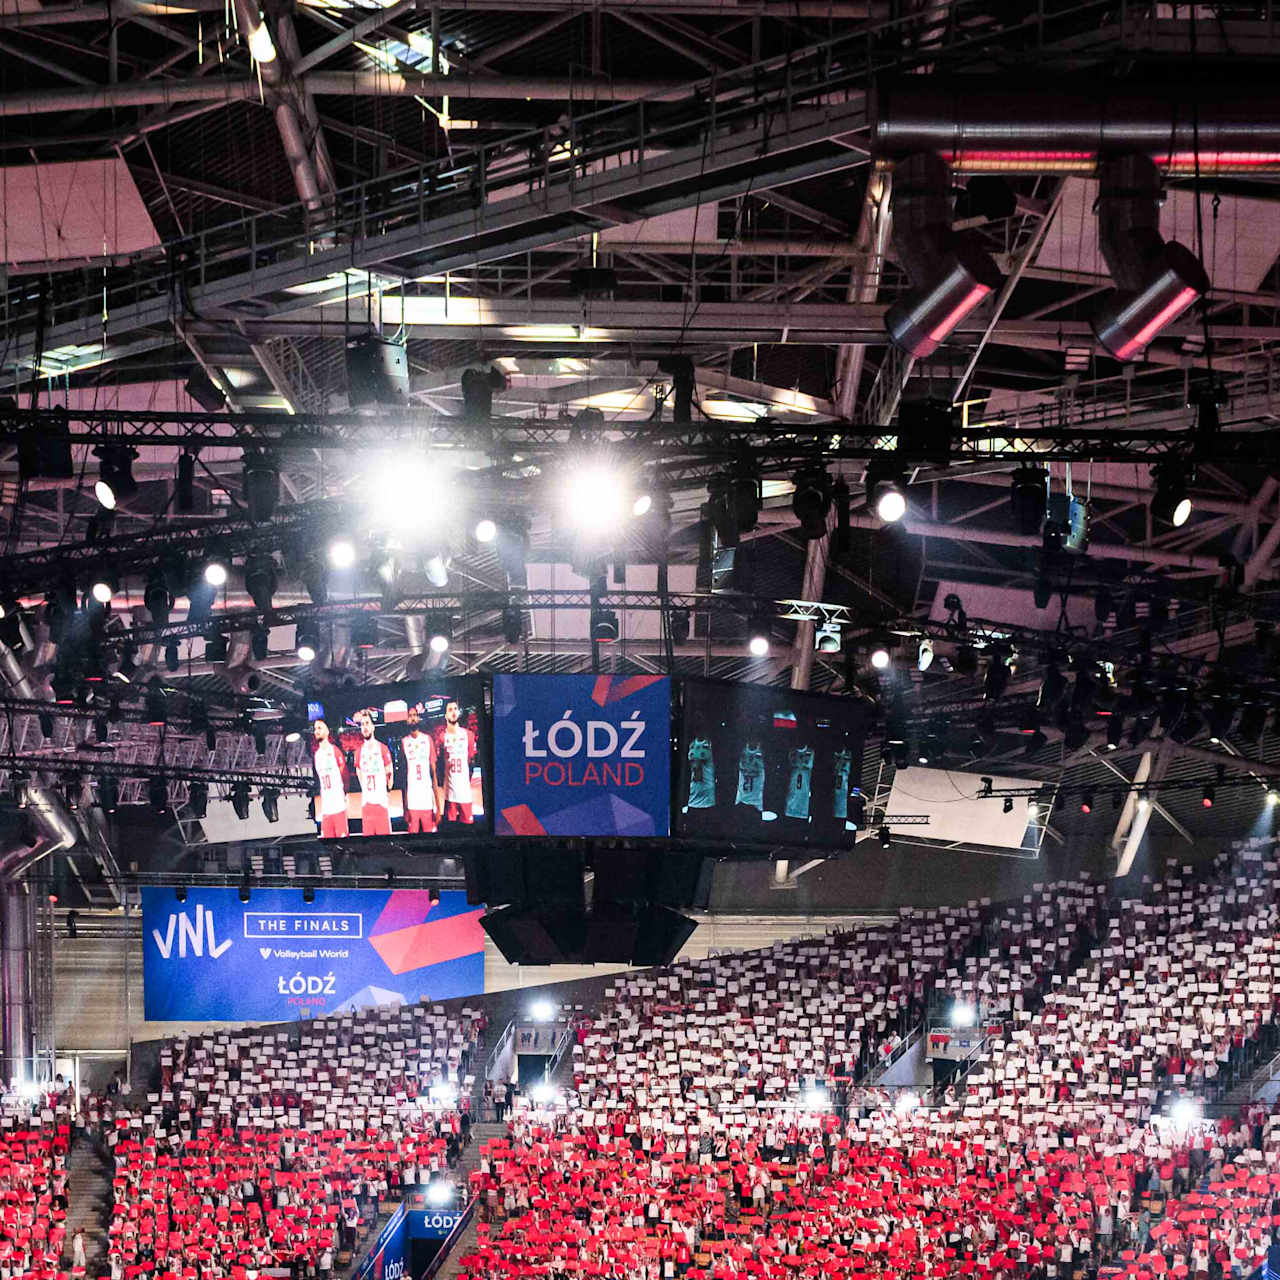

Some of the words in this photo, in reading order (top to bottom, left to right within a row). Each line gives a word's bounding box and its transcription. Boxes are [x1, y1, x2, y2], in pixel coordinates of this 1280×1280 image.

[522, 710, 646, 758] ŁÓDŹ
[525, 762, 645, 786] POLAND
[152, 904, 233, 959] VNL
[258, 919, 287, 931] THE
[295, 920, 350, 932] FINALS
[273, 949, 318, 960] Volleyball
[319, 949, 349, 959] World
[277, 972, 336, 995] ŁÓDŹ
